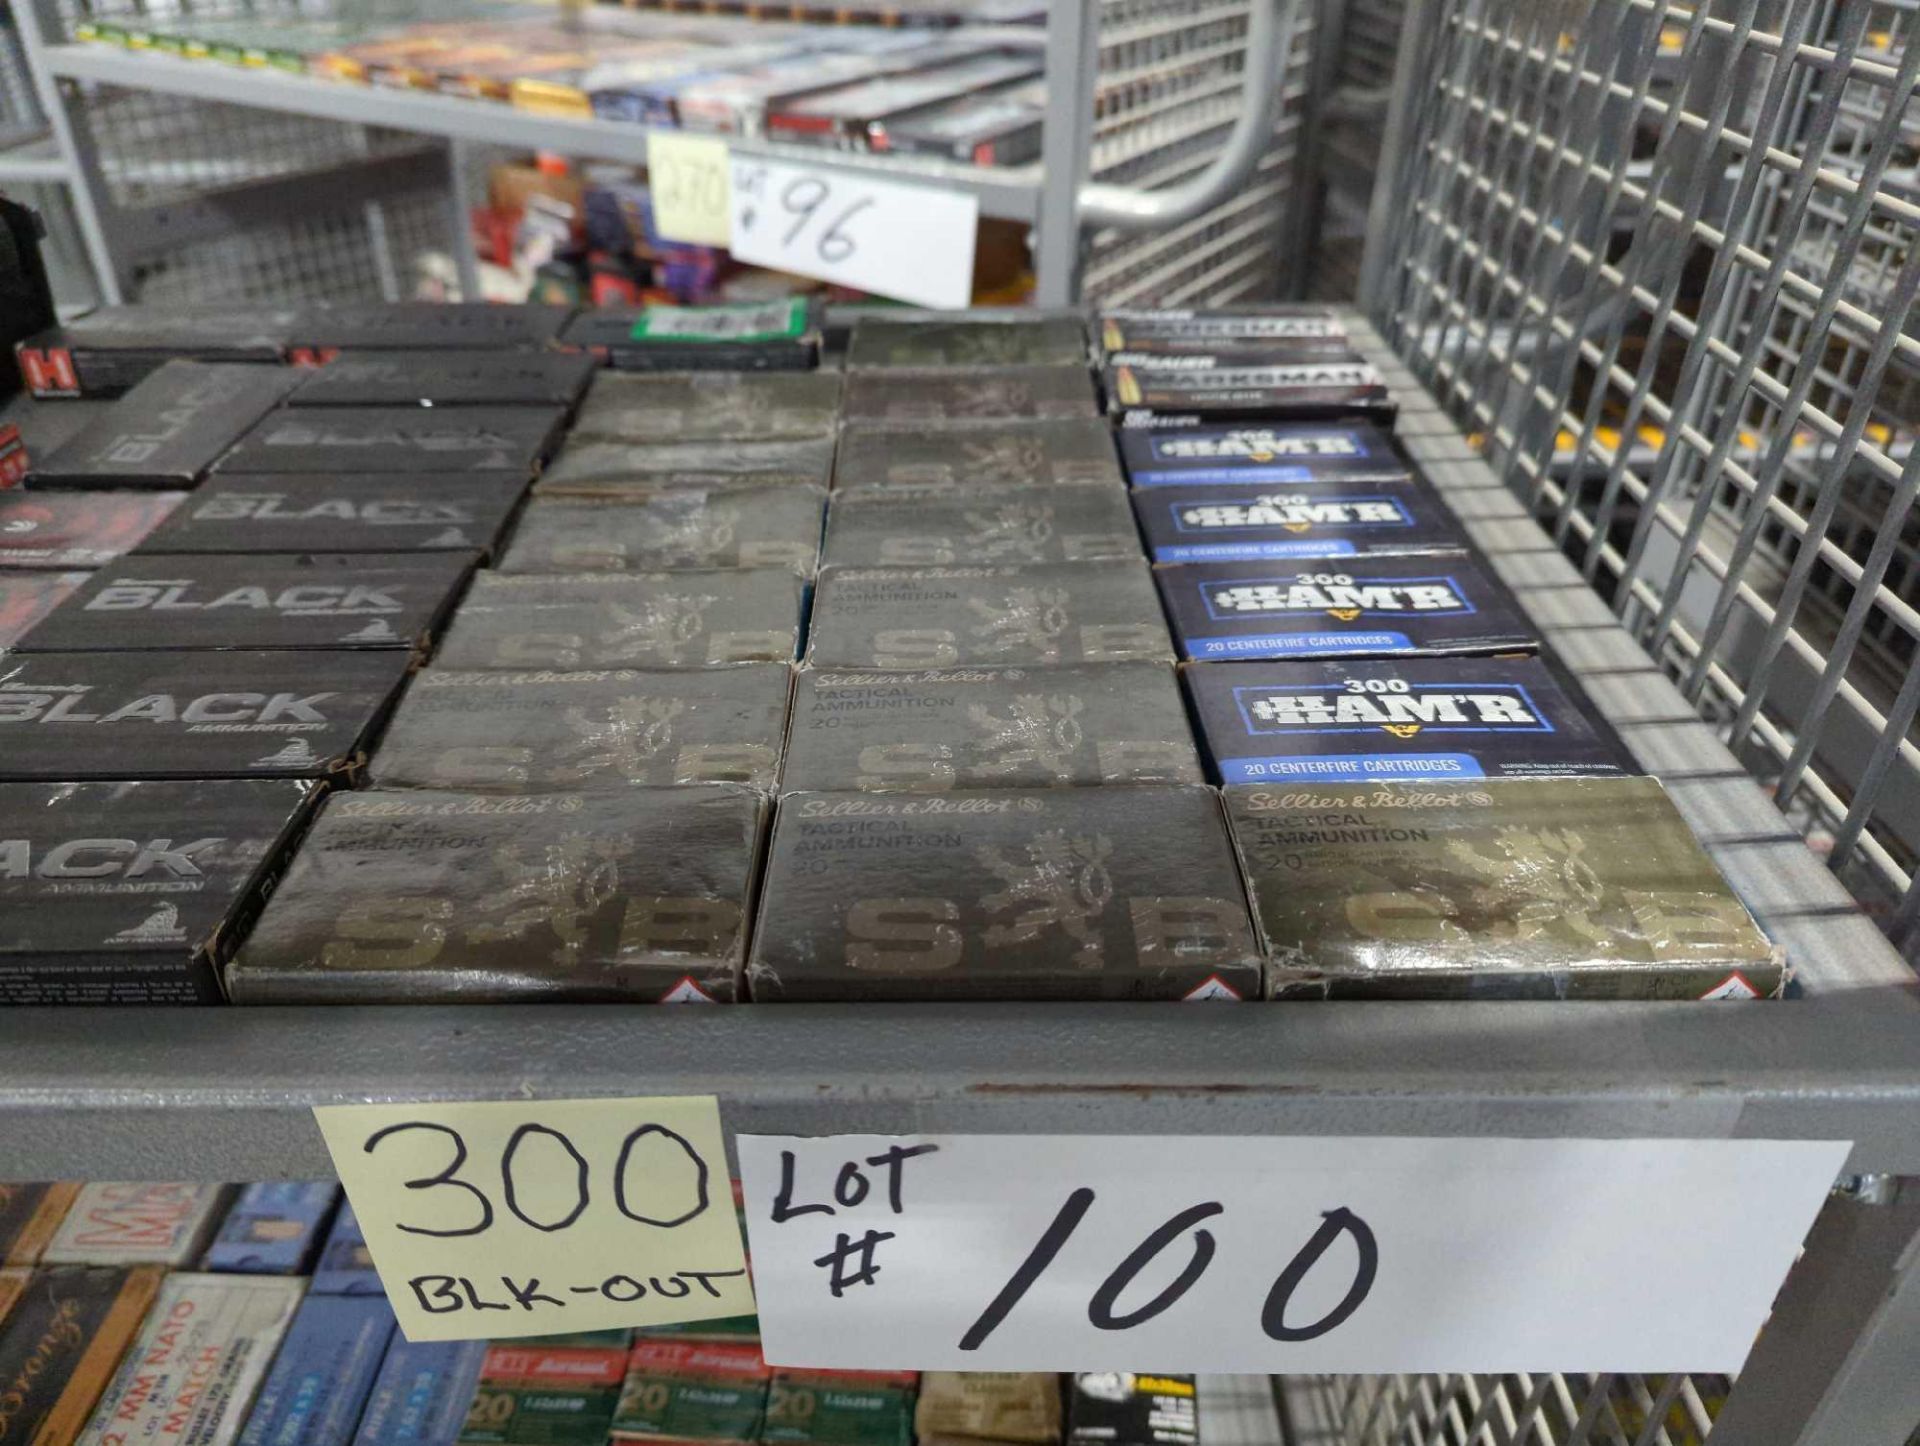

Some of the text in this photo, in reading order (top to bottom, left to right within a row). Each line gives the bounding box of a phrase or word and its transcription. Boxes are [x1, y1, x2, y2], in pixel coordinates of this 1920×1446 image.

[780, 174, 875, 263] 96
[1256, 494, 1310, 506] 300
[1296, 573, 1355, 586] 300
[83, 584, 406, 611] BLACK
[1206, 634, 1393, 653] 20 CENTERFIRE CARTRIDGES
[815, 672, 899, 687] Sellier
[918, 670, 998, 684] Bellot
[1342, 678, 1410, 695] 300
[814, 686, 915, 701] TACTICAL
[810, 698, 956, 714] AMMUNITION
[809, 715, 842, 730] 20
[1245, 758, 1461, 776] 20 CENTERFIRE CARTRIDGES
[335, 801, 436, 818] Sellier
[456, 798, 550, 814] Bellot
[798, 800, 898, 818] Sellier
[919, 797, 1011, 815] Bellot
[1246, 790, 1463, 811] Sellier & Bellot
[800, 820, 915, 836] TACTICAL
[1255, 813, 1374, 830] TACTICAL
[794, 833, 963, 852] AMMUNITION
[1258, 828, 1431, 847] AMMUNITION
[1265, 853, 1302, 872] 20
[845, 897, 1244, 971] S B
[363, 1121, 709, 1238] 300
[773, 1145, 938, 1223] LOT
[816, 1230, 897, 1297] #
[958, 1184, 1379, 1353] 100
[407, 1268, 746, 1314] BLK-OUT
[117, 1374, 157, 1421] MM
[144, 1300, 196, 1365] NATO
[162, 1344, 223, 1434] MATCH
[624, 1383, 668, 1412] 20
[470, 1393, 516, 1423] 20
